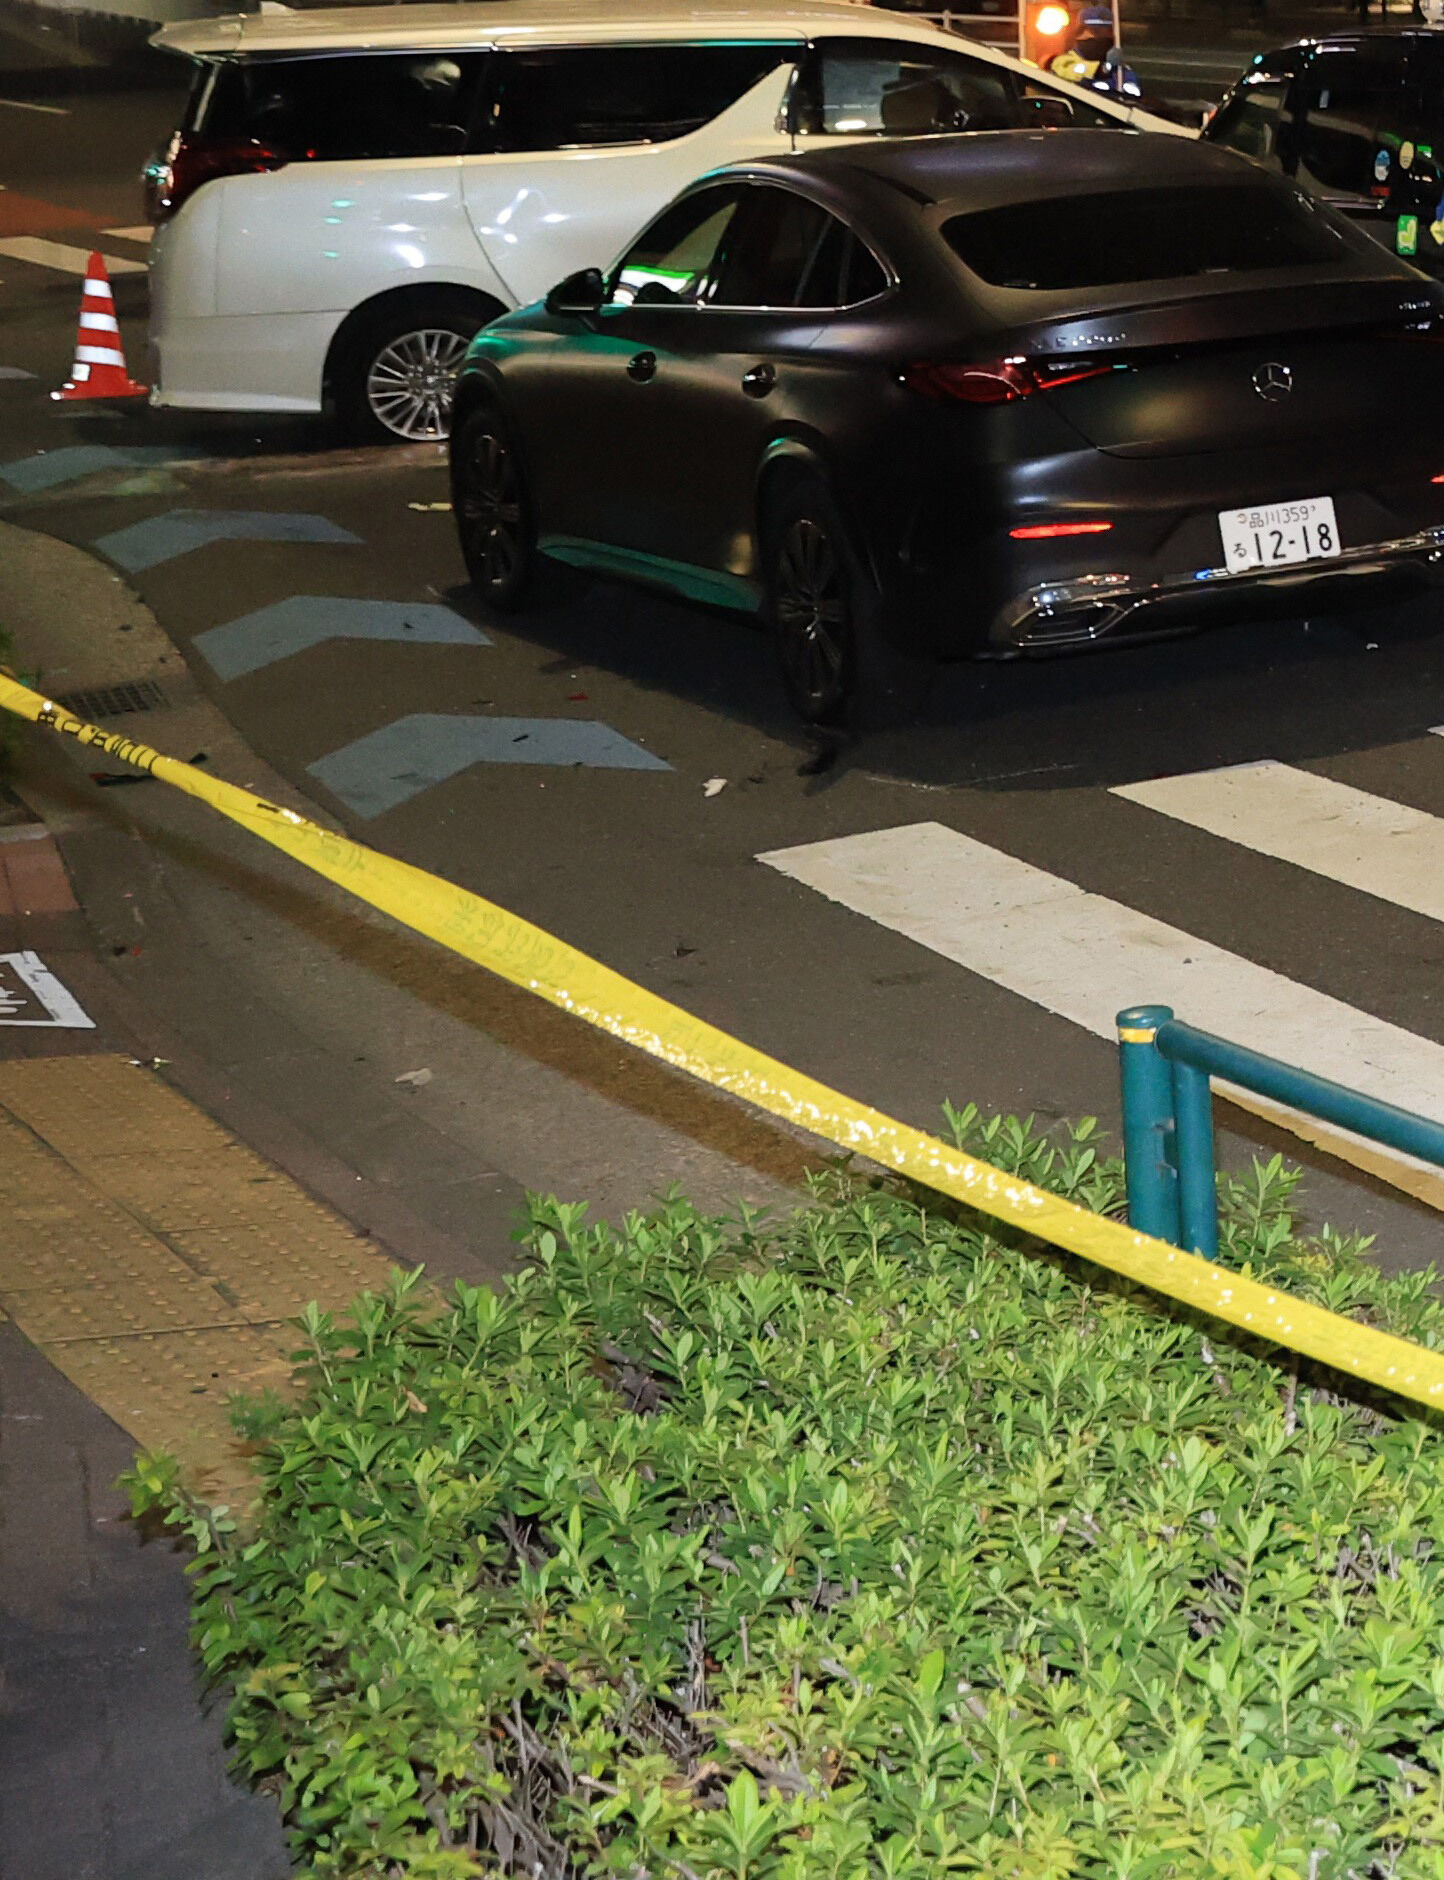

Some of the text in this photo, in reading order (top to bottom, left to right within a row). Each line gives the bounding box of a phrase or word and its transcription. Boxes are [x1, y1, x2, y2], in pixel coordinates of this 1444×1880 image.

[1248, 504, 1310, 529] 品川359
[1233, 522, 1333, 562] る 12-18
